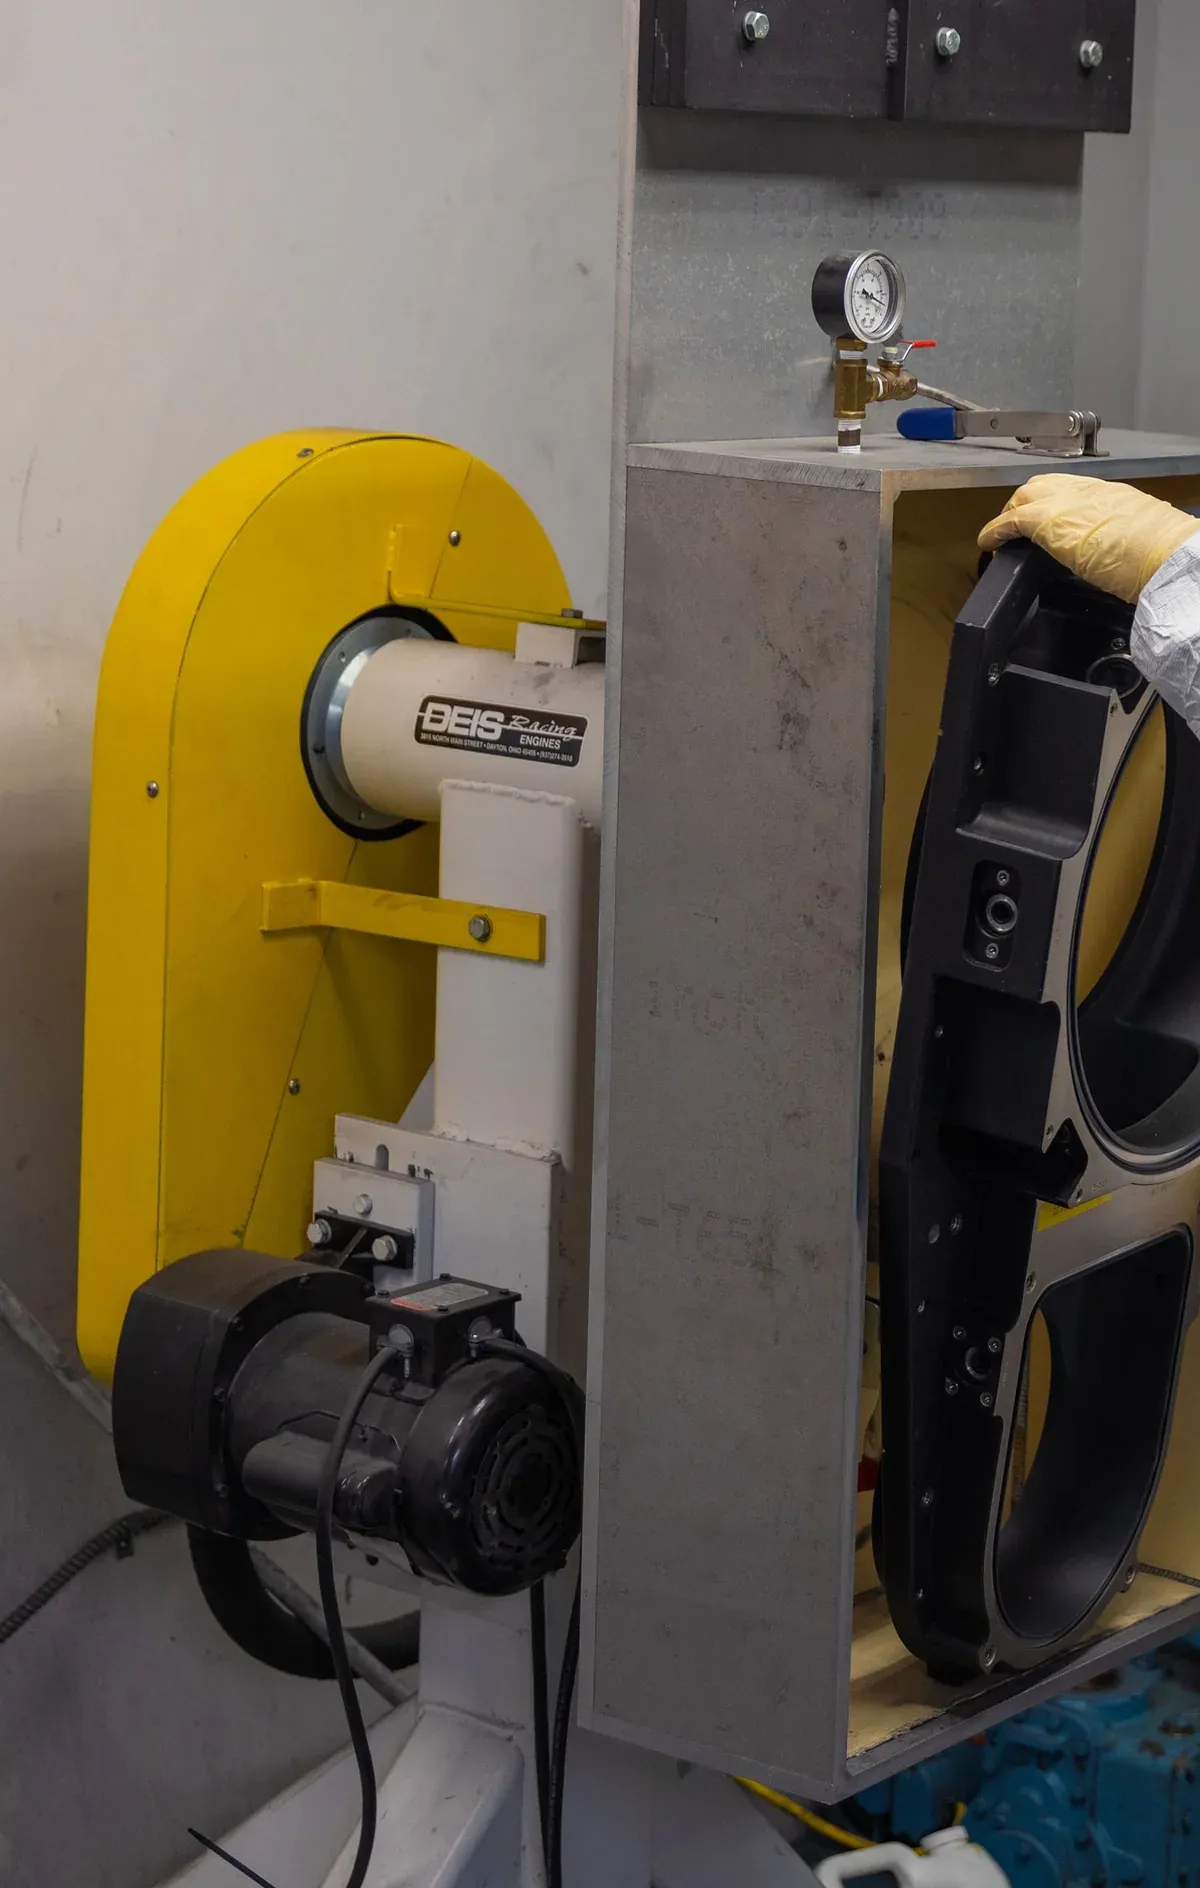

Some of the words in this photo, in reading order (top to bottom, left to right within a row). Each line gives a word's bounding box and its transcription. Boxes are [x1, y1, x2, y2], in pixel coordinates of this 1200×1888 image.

[509, 714, 577, 741] Racing
[432, 734, 449, 743] NORTH
[450, 736, 463, 746] MAIN
[463, 738, 483, 749] STREET
[508, 745, 521, 755] OHIO
[520, 734, 561, 750] ENGINES
